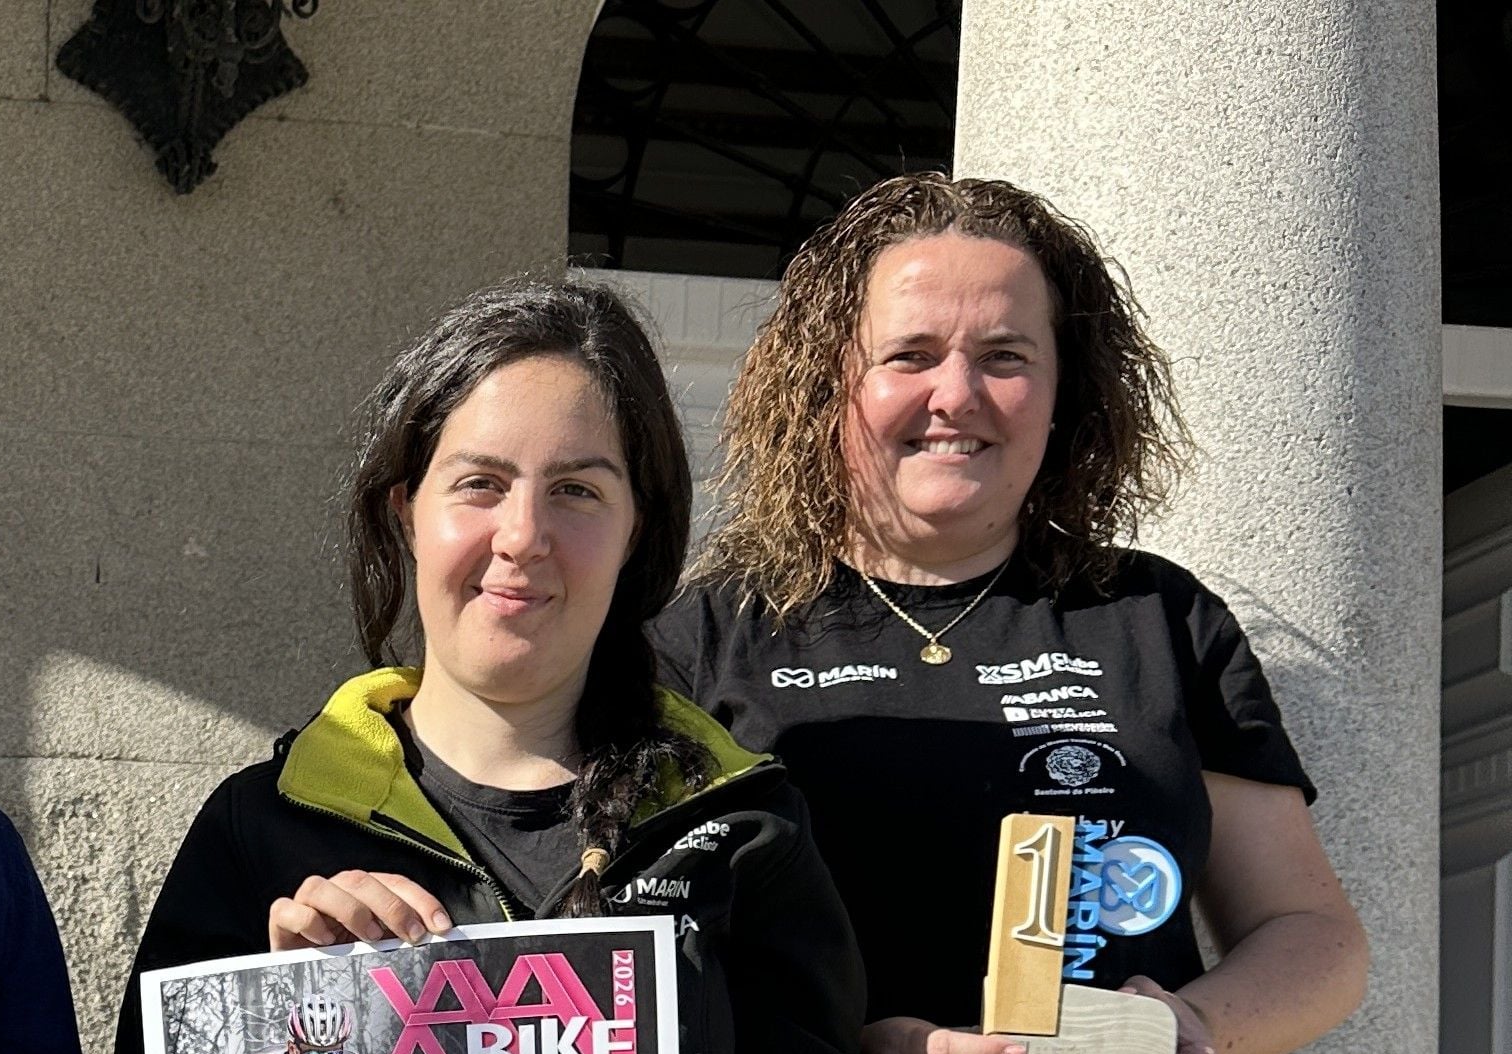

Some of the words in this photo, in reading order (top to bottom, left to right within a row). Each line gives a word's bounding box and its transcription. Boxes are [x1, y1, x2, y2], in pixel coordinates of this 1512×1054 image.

[637, 876, 691, 899] MARÍN
[1063, 824, 1108, 980] MARÍN
[613, 952, 634, 1007] 2026
